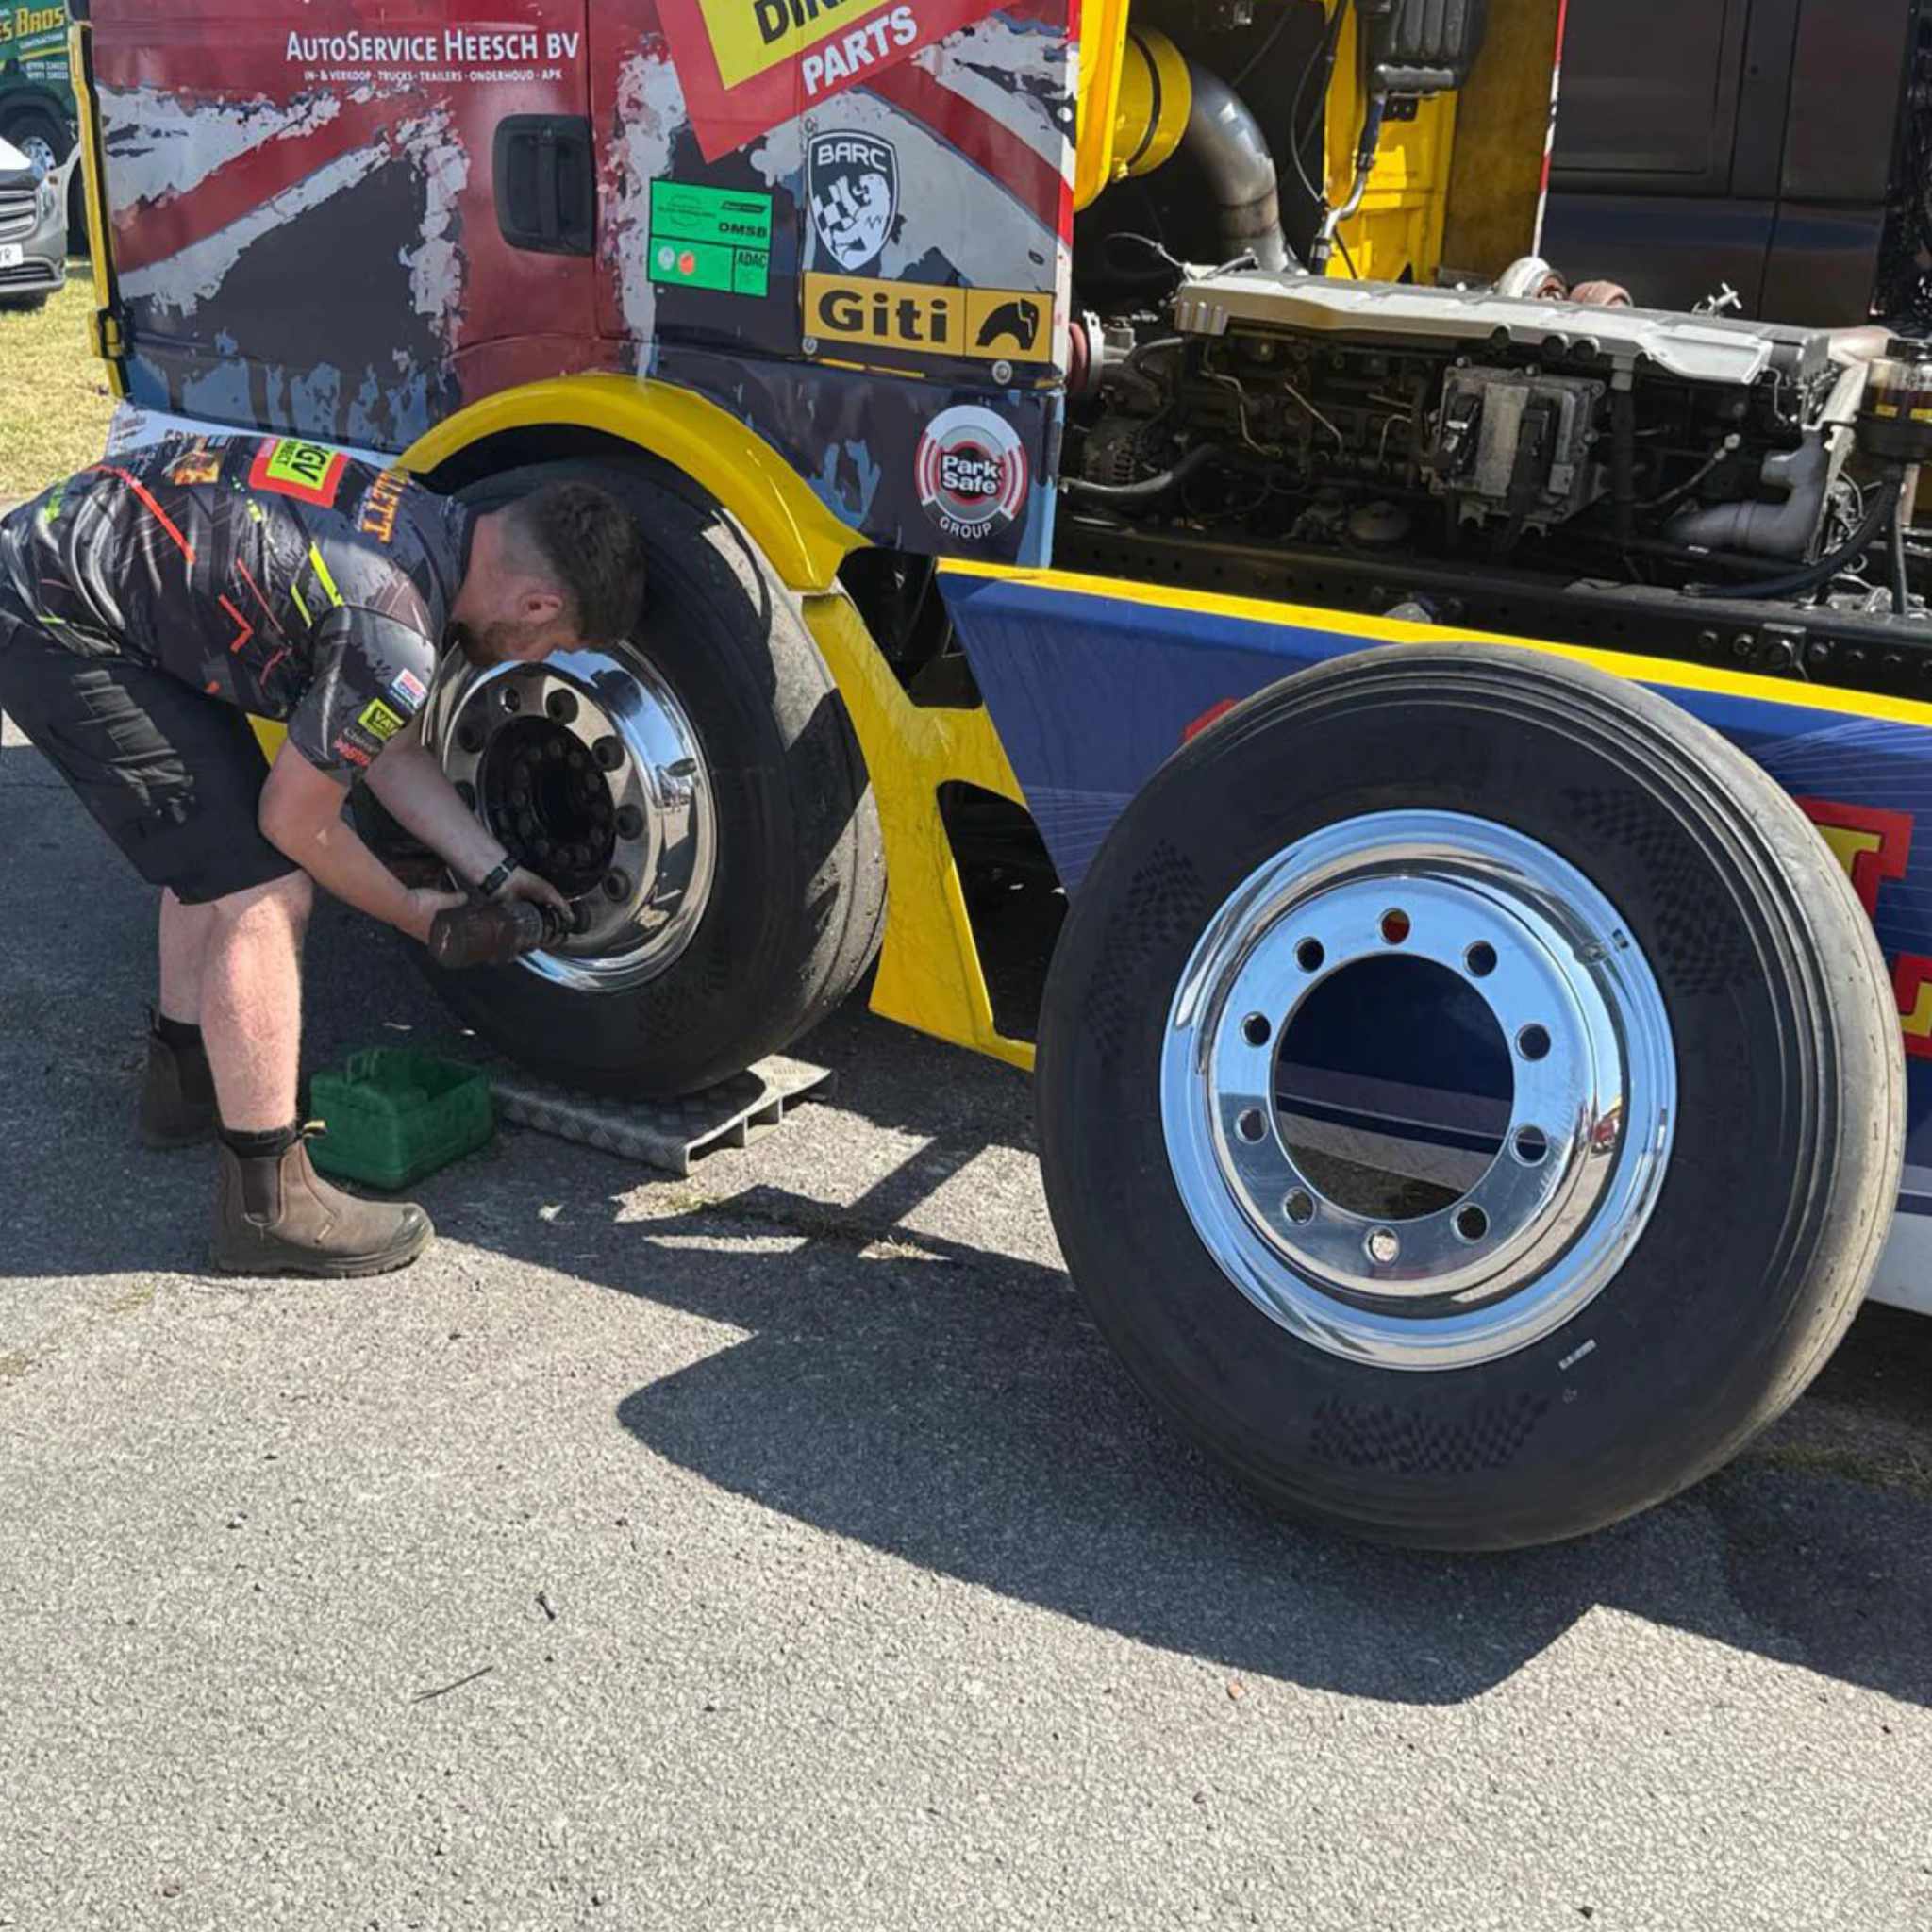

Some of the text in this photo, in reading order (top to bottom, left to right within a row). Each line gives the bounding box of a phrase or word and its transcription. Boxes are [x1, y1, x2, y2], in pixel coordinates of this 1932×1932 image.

[444, 29, 539, 62] HEESCH
[546, 33, 580, 59] BV
[802, 6, 918, 95] PARTS
[817, 142, 889, 172] BARC
[738, 251, 768, 269] ADAC
[818, 290, 947, 343] Giti
[942, 455, 998, 477] Park
[942, 472, 998, 495] Safe
[940, 516, 993, 539] GROUP
